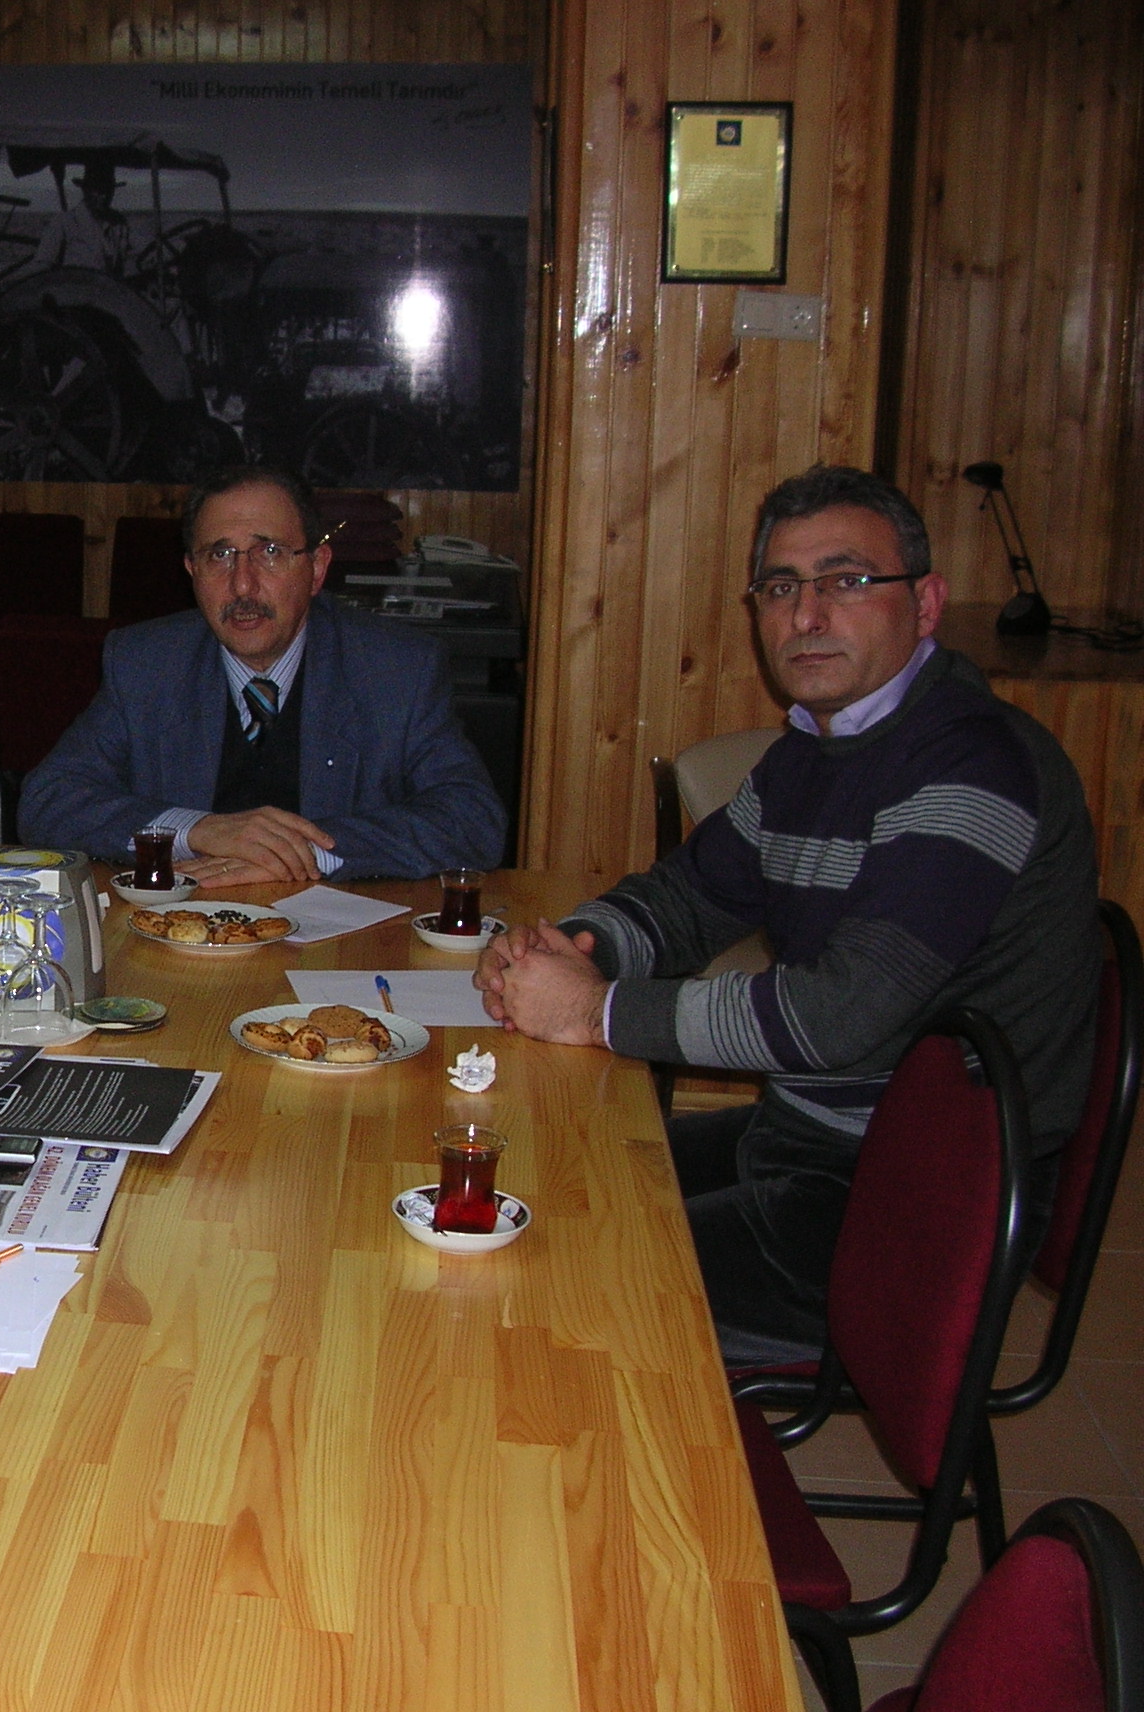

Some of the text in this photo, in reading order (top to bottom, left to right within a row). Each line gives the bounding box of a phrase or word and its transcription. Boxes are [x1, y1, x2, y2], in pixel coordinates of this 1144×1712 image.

[204, 80, 313, 99] Ekonominin
[319, 80, 382, 99] Temeli
[79, 1162, 112, 1185] Haber
[65, 1186, 102, 1213] Bülteni
